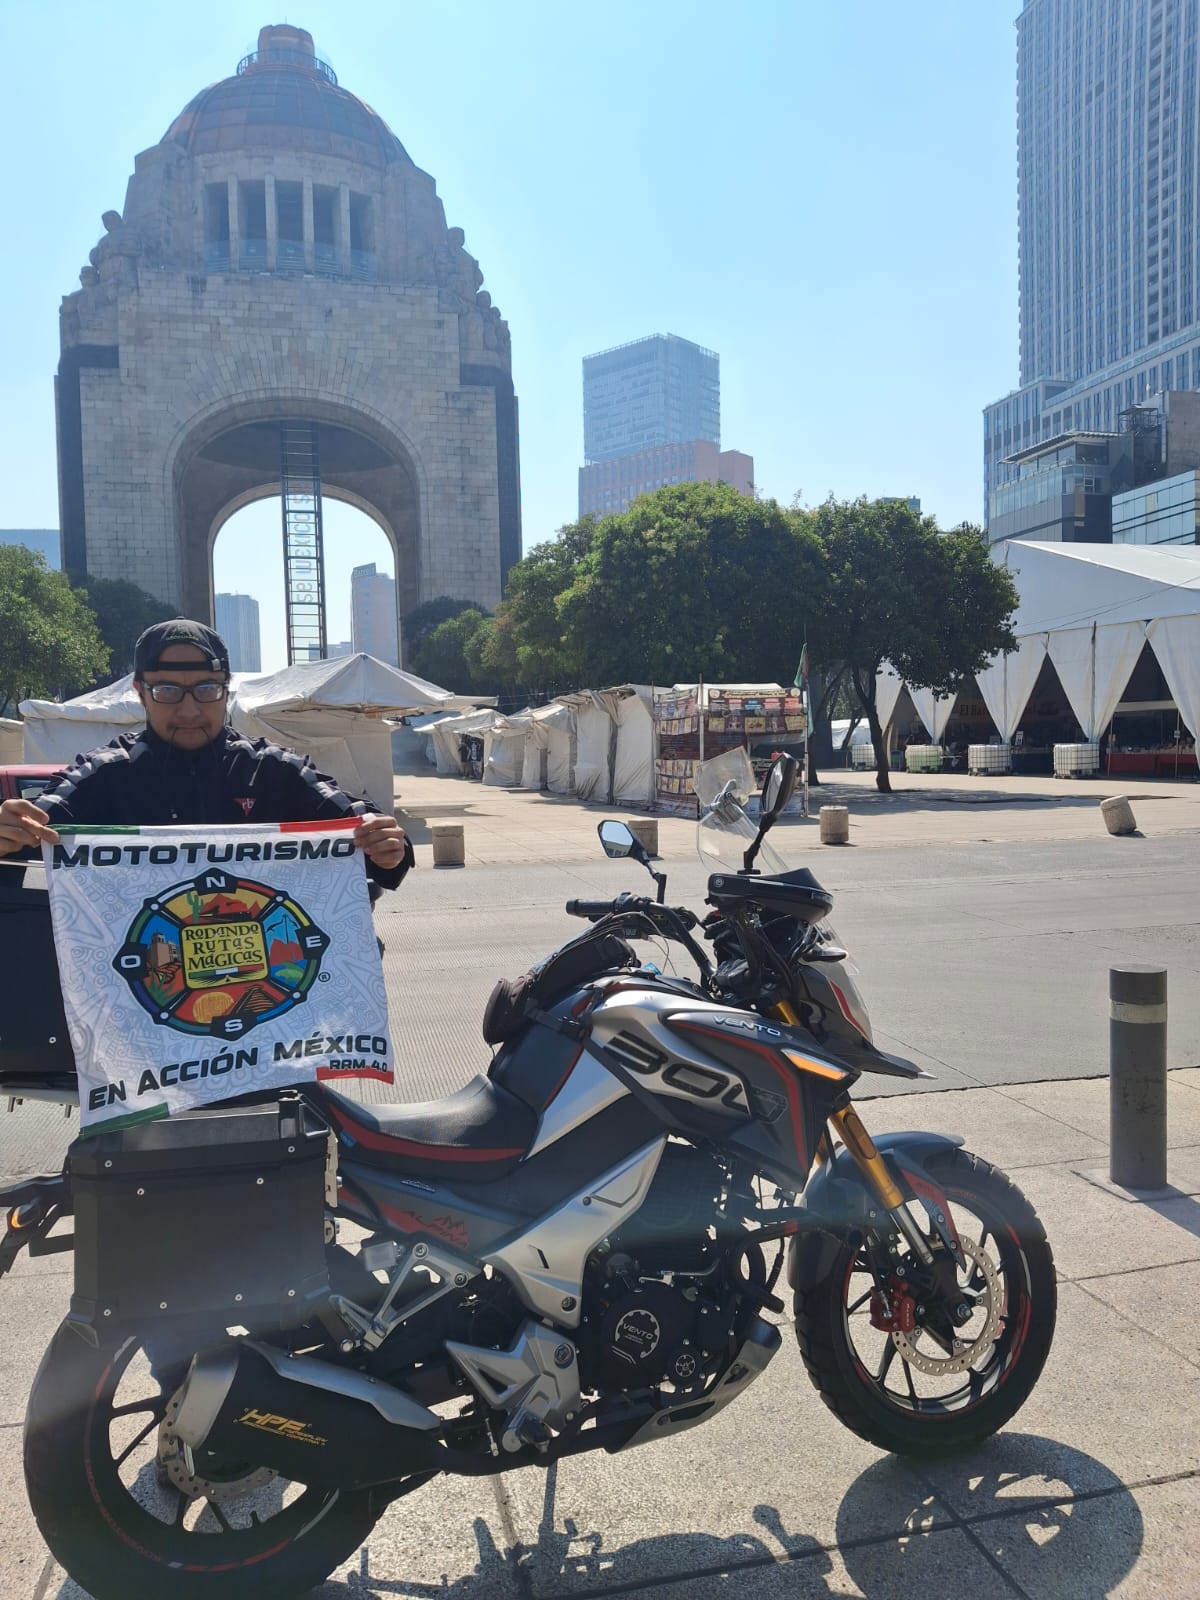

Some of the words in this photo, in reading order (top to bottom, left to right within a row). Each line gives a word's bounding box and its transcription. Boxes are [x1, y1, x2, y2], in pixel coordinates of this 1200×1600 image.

[52, 839, 356, 869] MOTOTURISMO
[206, 875, 226, 888] N
[305, 935, 323, 948] E
[120, 955, 141, 968] O
[225, 1019, 243, 1032] S
[713, 1015, 781, 1037] VENTO
[89, 1080, 127, 1111] EN
[137, 1046, 258, 1096] ACCIÓN
[273, 1031, 387, 1061] MÉXICO
[329, 1059, 366, 1070] RRM
[371, 1060, 388, 1073] 4.0
[623, 1323, 654, 1340] VENTO
